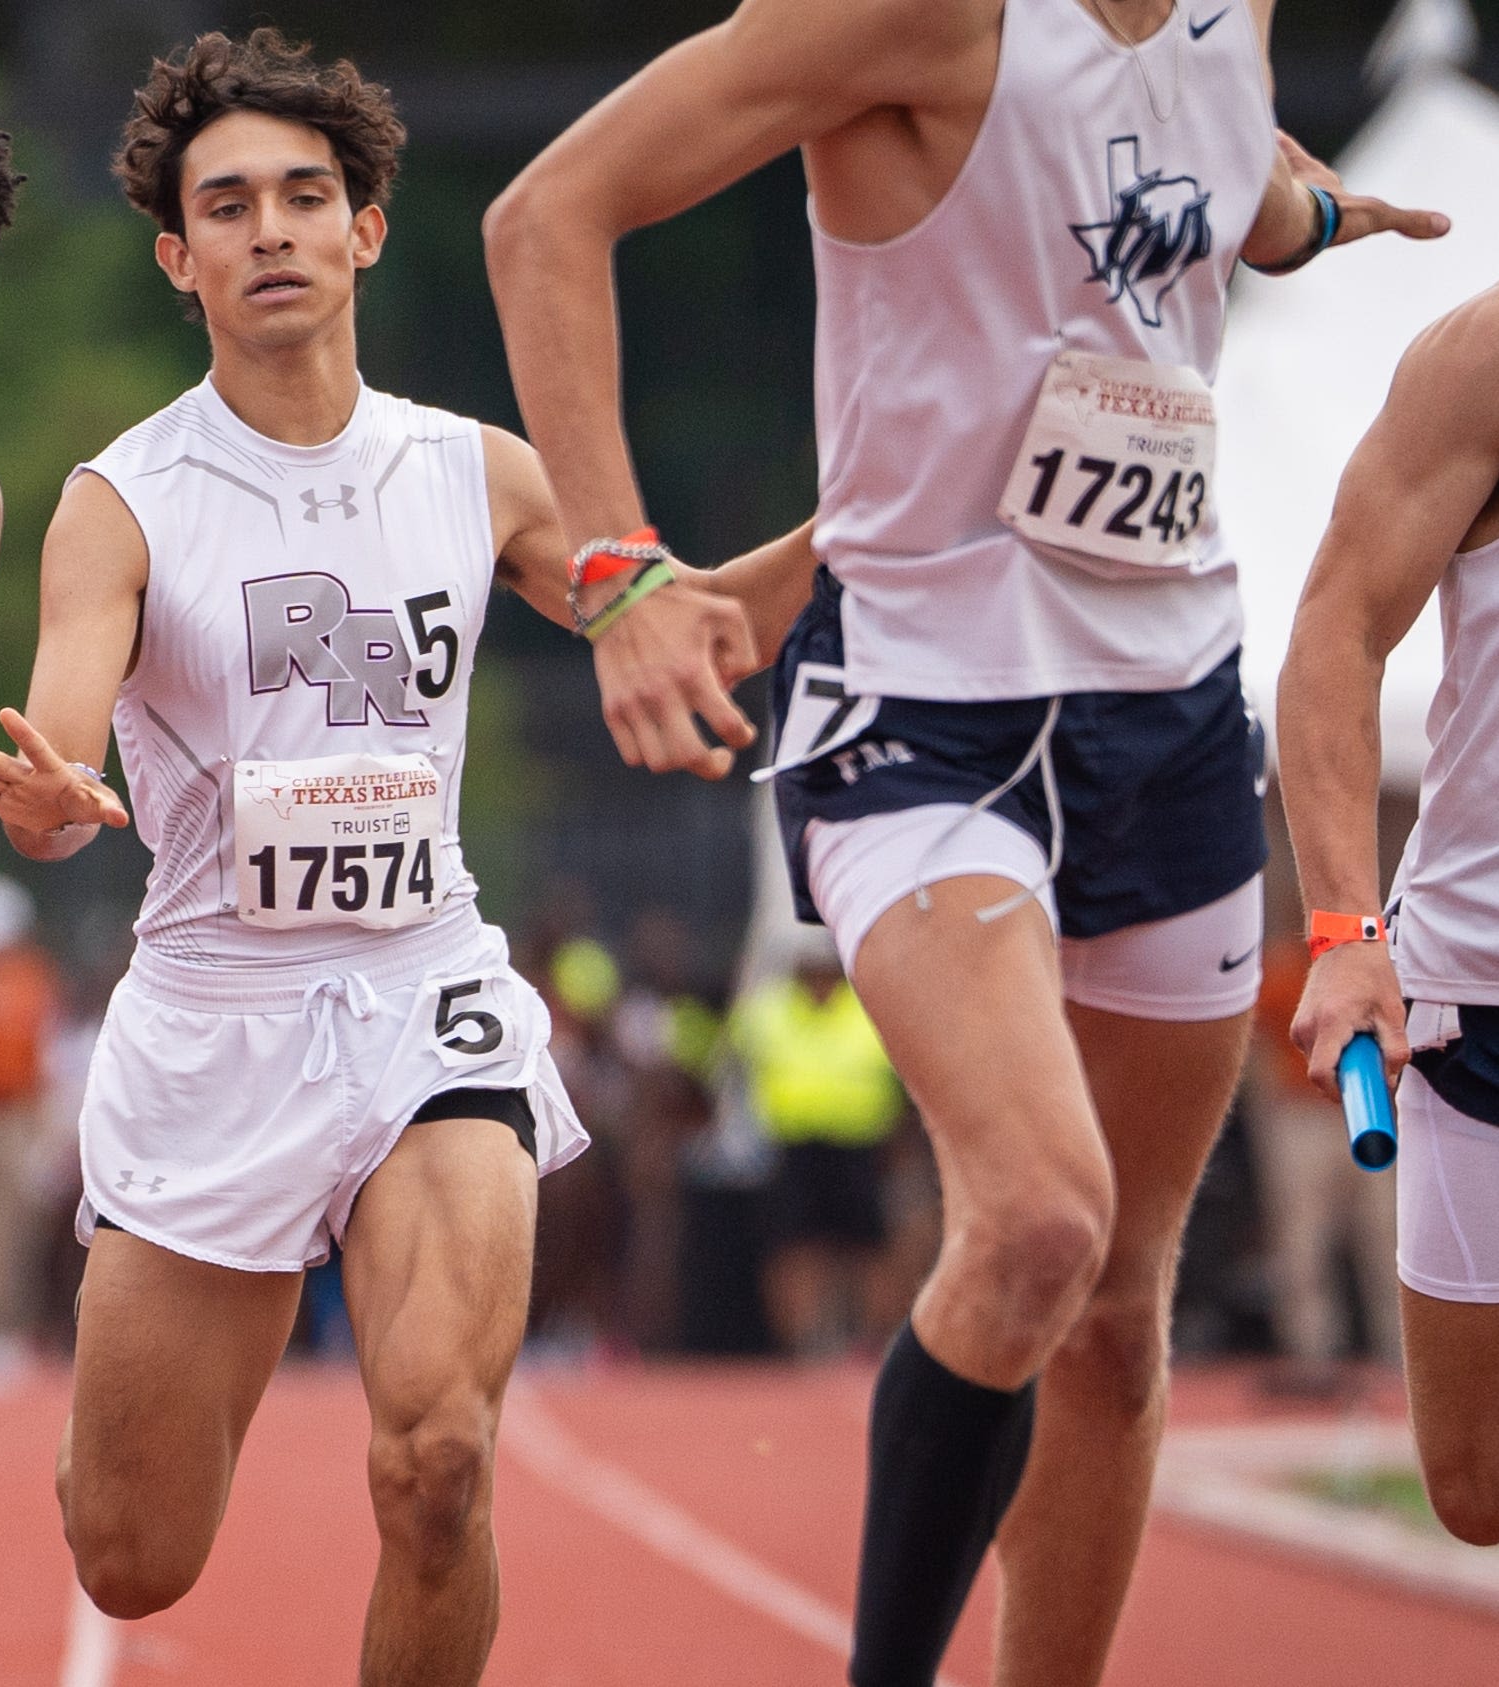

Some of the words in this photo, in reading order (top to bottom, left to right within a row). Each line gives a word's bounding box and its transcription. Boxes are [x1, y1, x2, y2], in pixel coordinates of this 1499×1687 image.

[1126, 435, 1179, 458] TRUIST
[1026, 448, 1205, 544] 17243
[242, 571, 430, 727] RR
[404, 590, 459, 699] 5
[806, 678, 860, 754] 7
[292, 776, 345, 787] CLYDE
[353, 769, 435, 786] LITTLEFIELD
[292, 787, 367, 805] TEXAS
[373, 780, 437, 801] RELAYS
[331, 818, 391, 835] TRUIST
[249, 838, 434, 912] 17574
[434, 978, 504, 1055] 5
